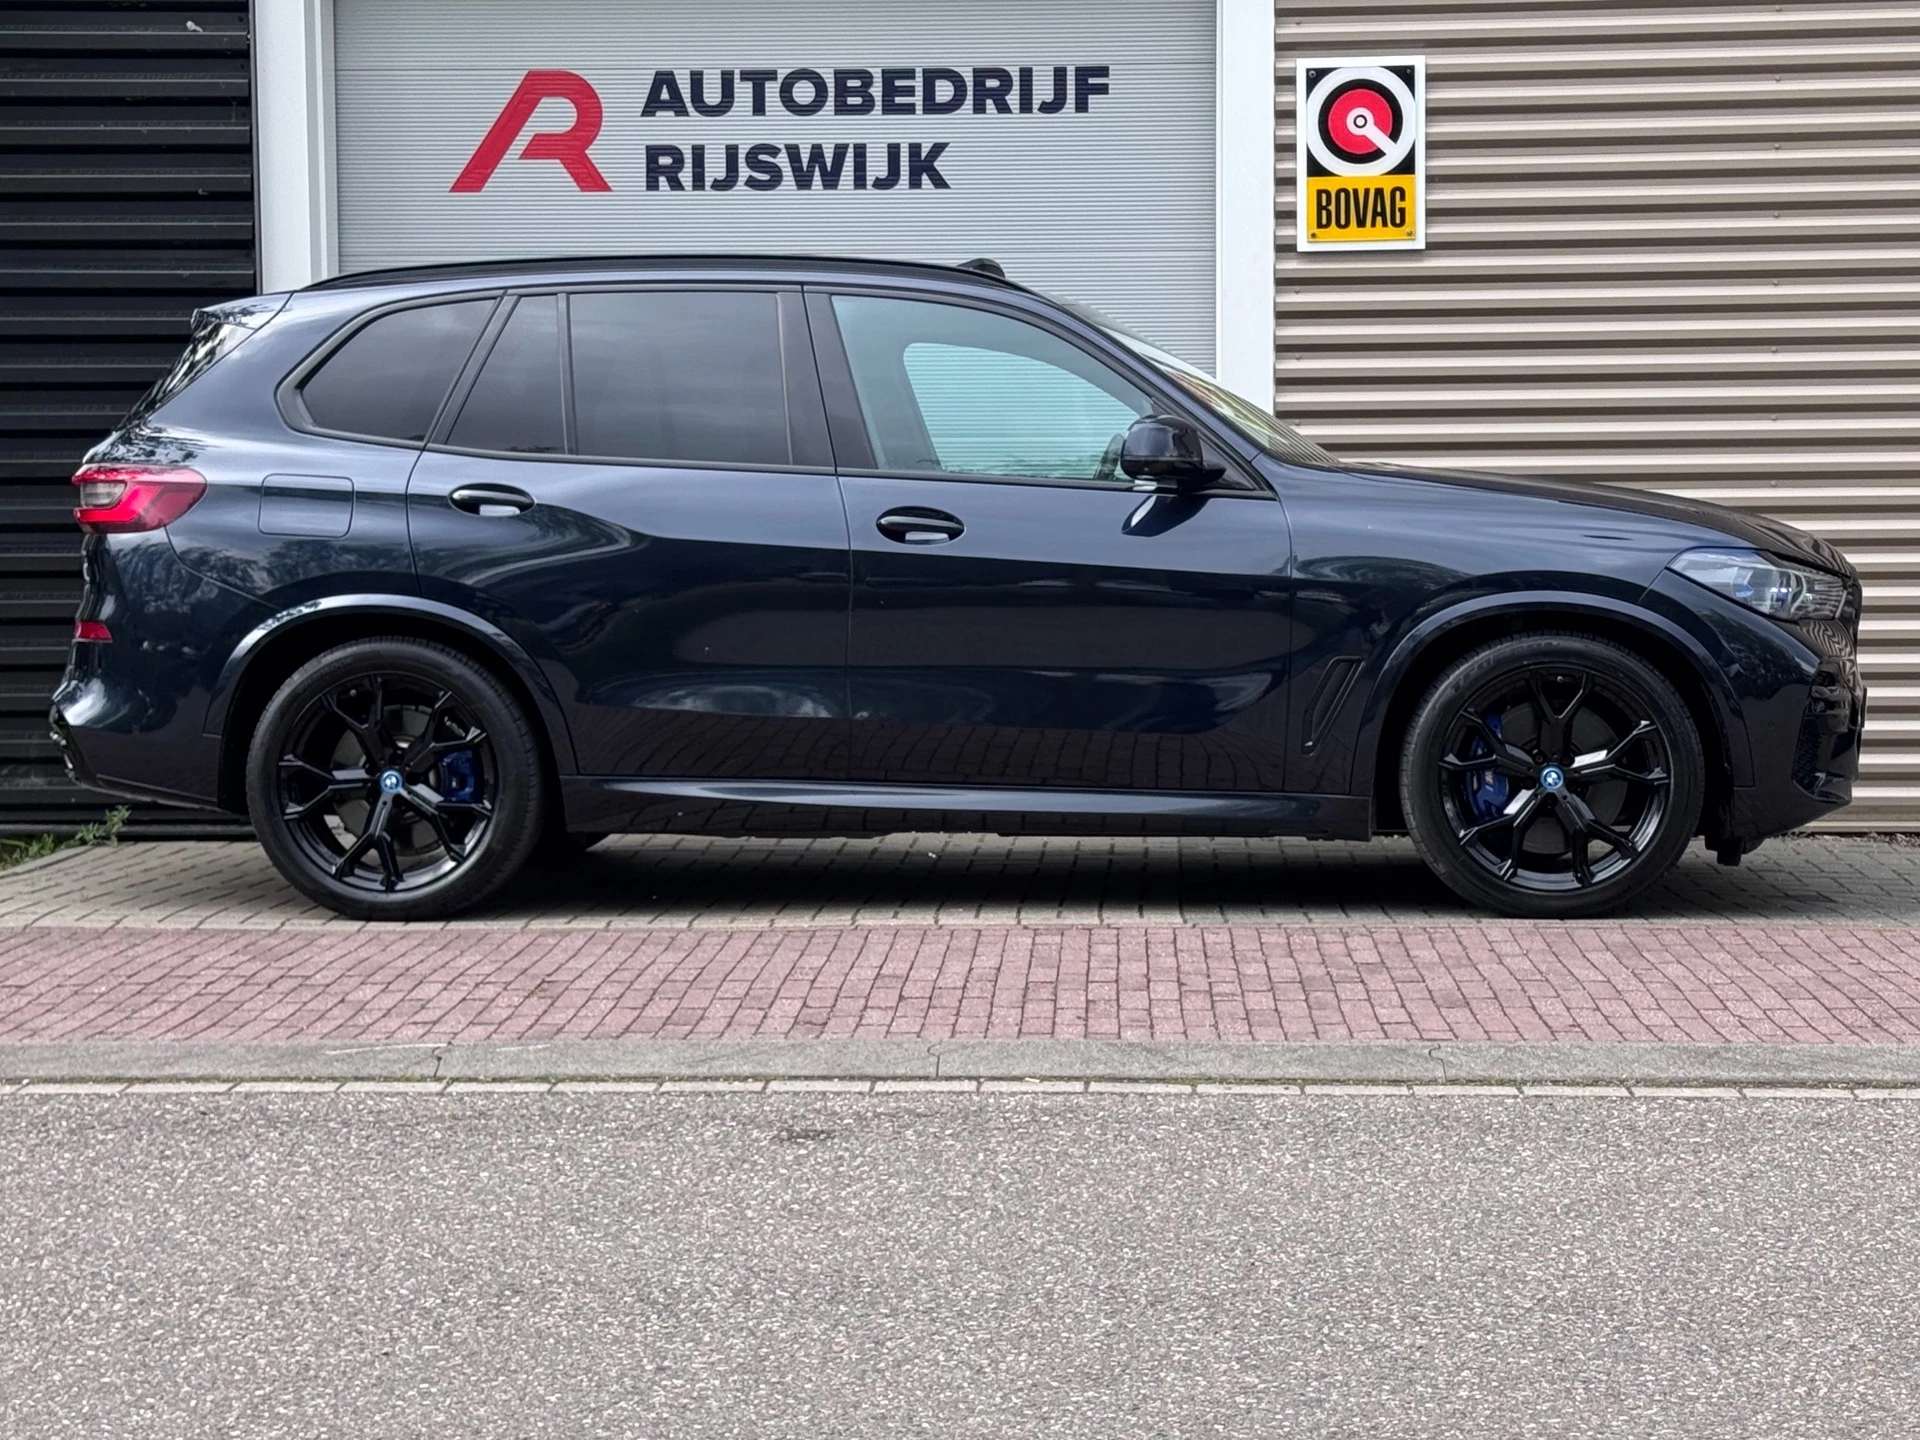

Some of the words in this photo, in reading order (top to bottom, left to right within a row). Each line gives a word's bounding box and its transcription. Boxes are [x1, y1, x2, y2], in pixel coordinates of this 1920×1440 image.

[640, 65, 1110, 118] AUTOBEDRIJF
[645, 142, 952, 192] RIJSWIJK
[1316, 186, 1407, 229] BOVAG
